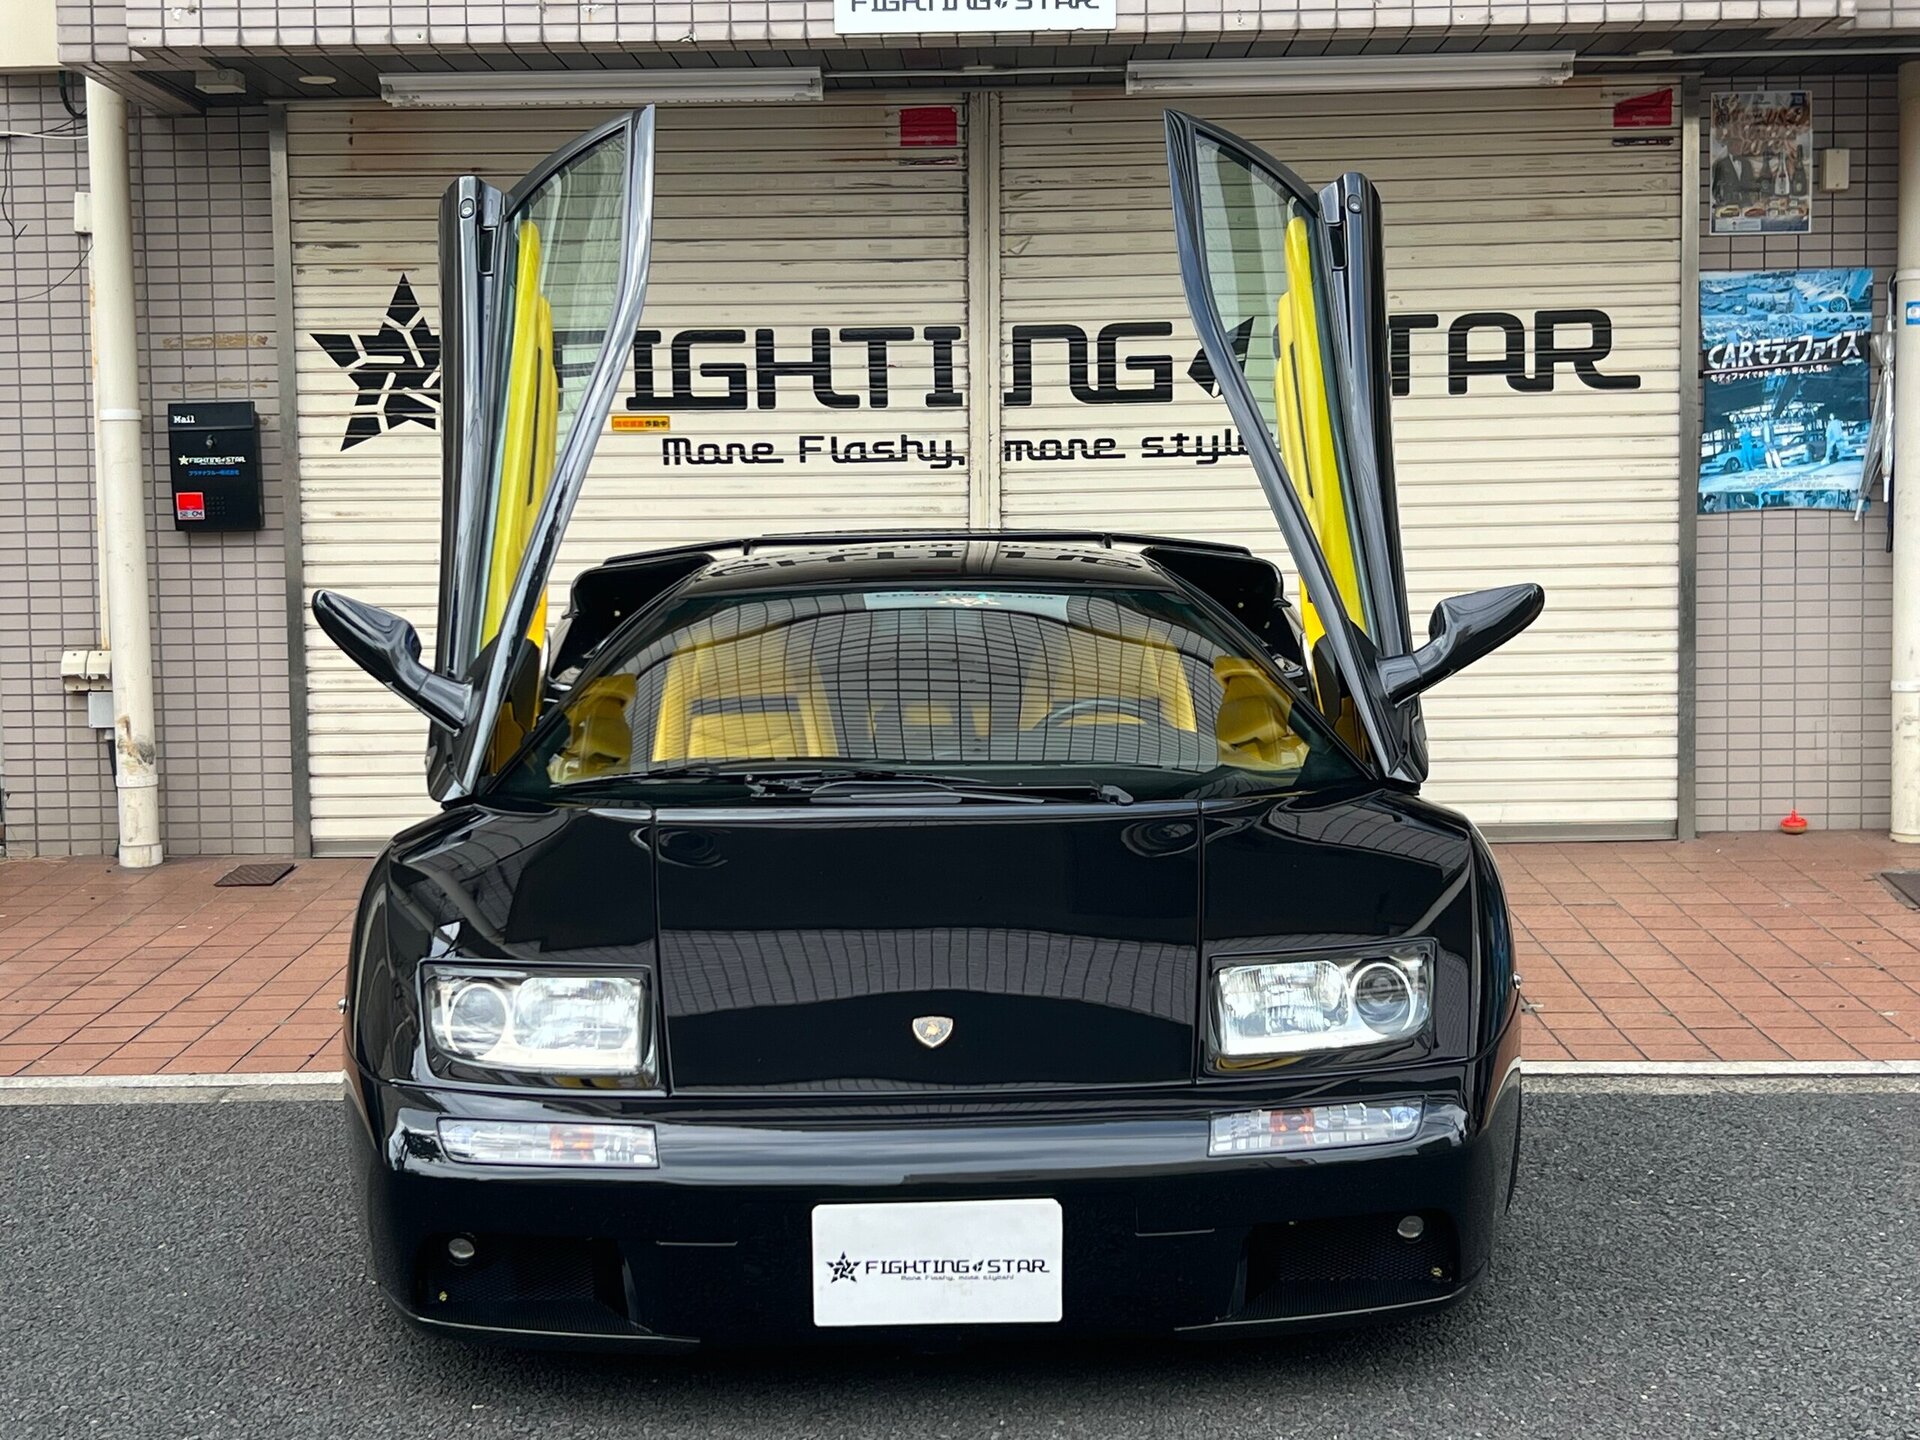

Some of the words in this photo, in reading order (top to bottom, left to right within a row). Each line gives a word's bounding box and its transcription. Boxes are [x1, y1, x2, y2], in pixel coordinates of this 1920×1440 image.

[1273, 308, 1641, 397] TAR
[173, 415, 195, 424] Mail
[799, 434, 966, 469] Flashy,
[866, 1260, 970, 1274] FIGHTING
[987, 1259, 1050, 1273] STAR
